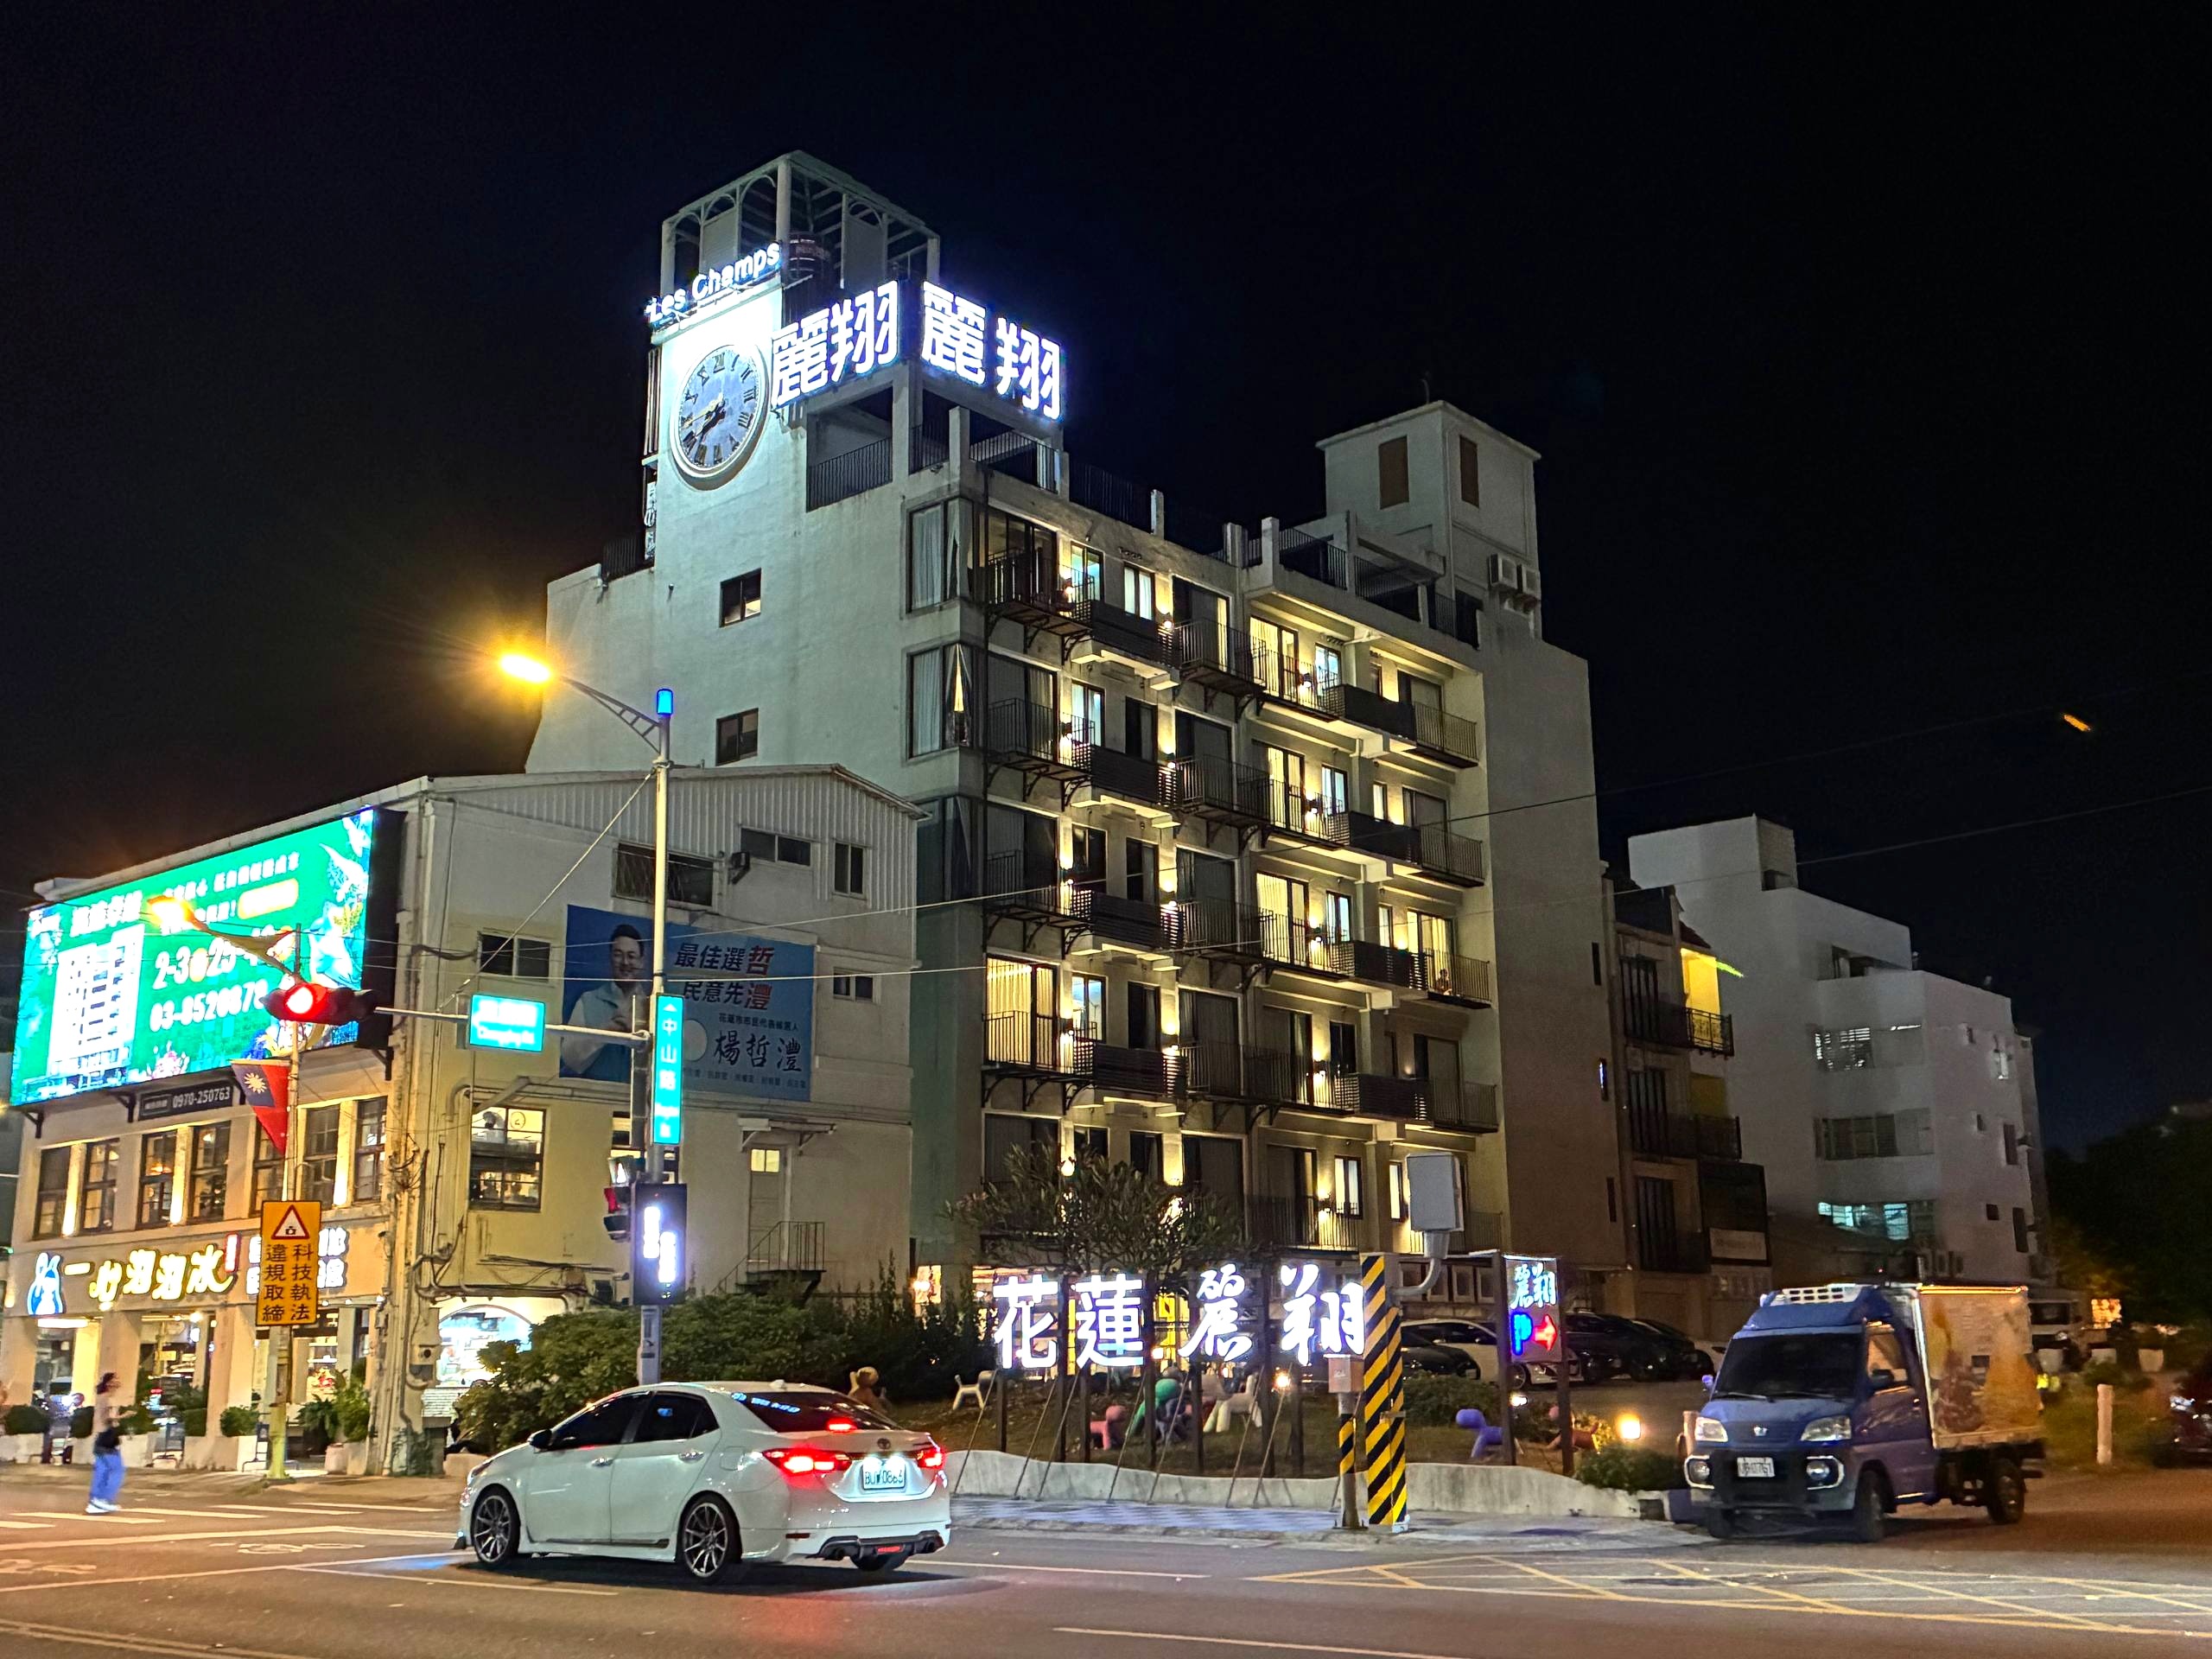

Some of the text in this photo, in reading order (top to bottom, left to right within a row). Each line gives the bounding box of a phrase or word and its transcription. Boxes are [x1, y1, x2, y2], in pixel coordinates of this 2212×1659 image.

[645, 243, 781, 323] Les Champs
[771, 280, 899, 409] 麗翔
[922, 281, 1062, 420] 麗翔
[674, 943, 774, 976] 最佳選哲
[173, 1086, 231, 1109] 0970-250763
[263, 1243, 288, 1322] 違規取締
[290, 1243, 314, 1321] 科技執法
[1512, 1312, 1533, 1356] P
